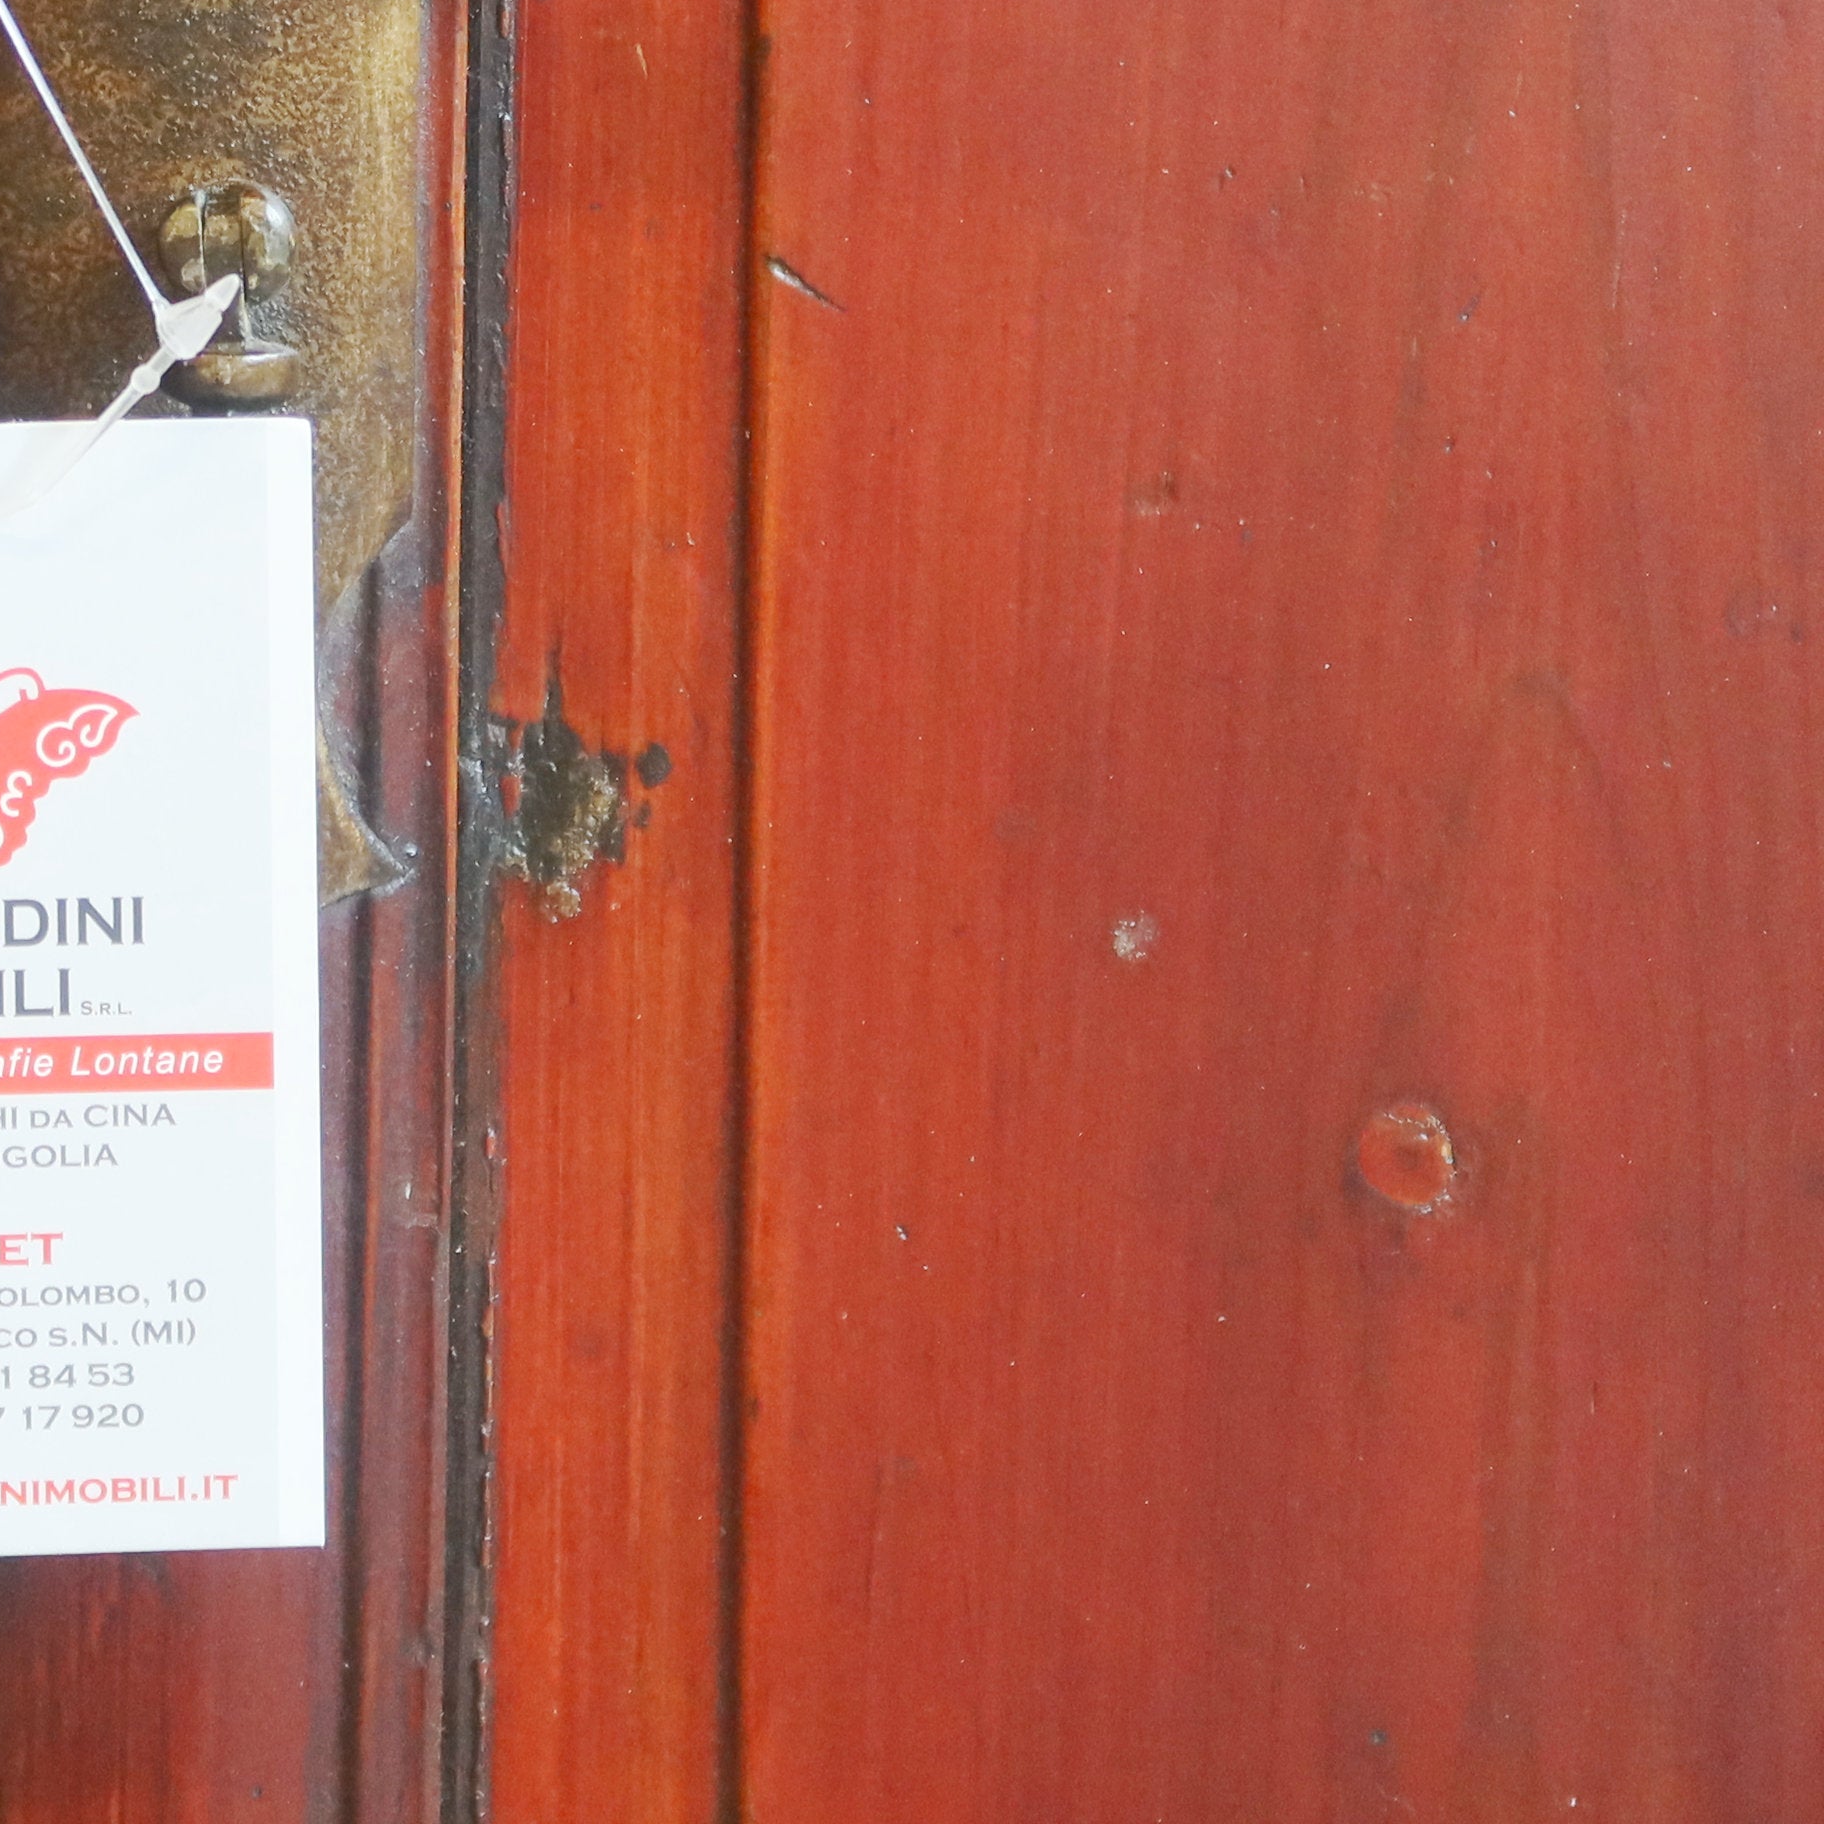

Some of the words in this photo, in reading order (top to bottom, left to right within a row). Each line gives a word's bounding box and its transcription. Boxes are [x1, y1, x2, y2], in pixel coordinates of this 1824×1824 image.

[80, 1000, 133, 1016] S.R.L.
[70, 1045, 224, 1077] Lontane
[29, 1108, 74, 1129] DA
[83, 1103, 176, 1128] CINA
[167, 1278, 207, 1303] 10
[48, 1321, 119, 1348] S.N.
[131, 1317, 196, 1347] (MI)
[28, 1363, 77, 1389] 84
[87, 1362, 135, 1388] 53
[22, 1405, 62, 1431] 17
[71, 1403, 145, 1429] 920
